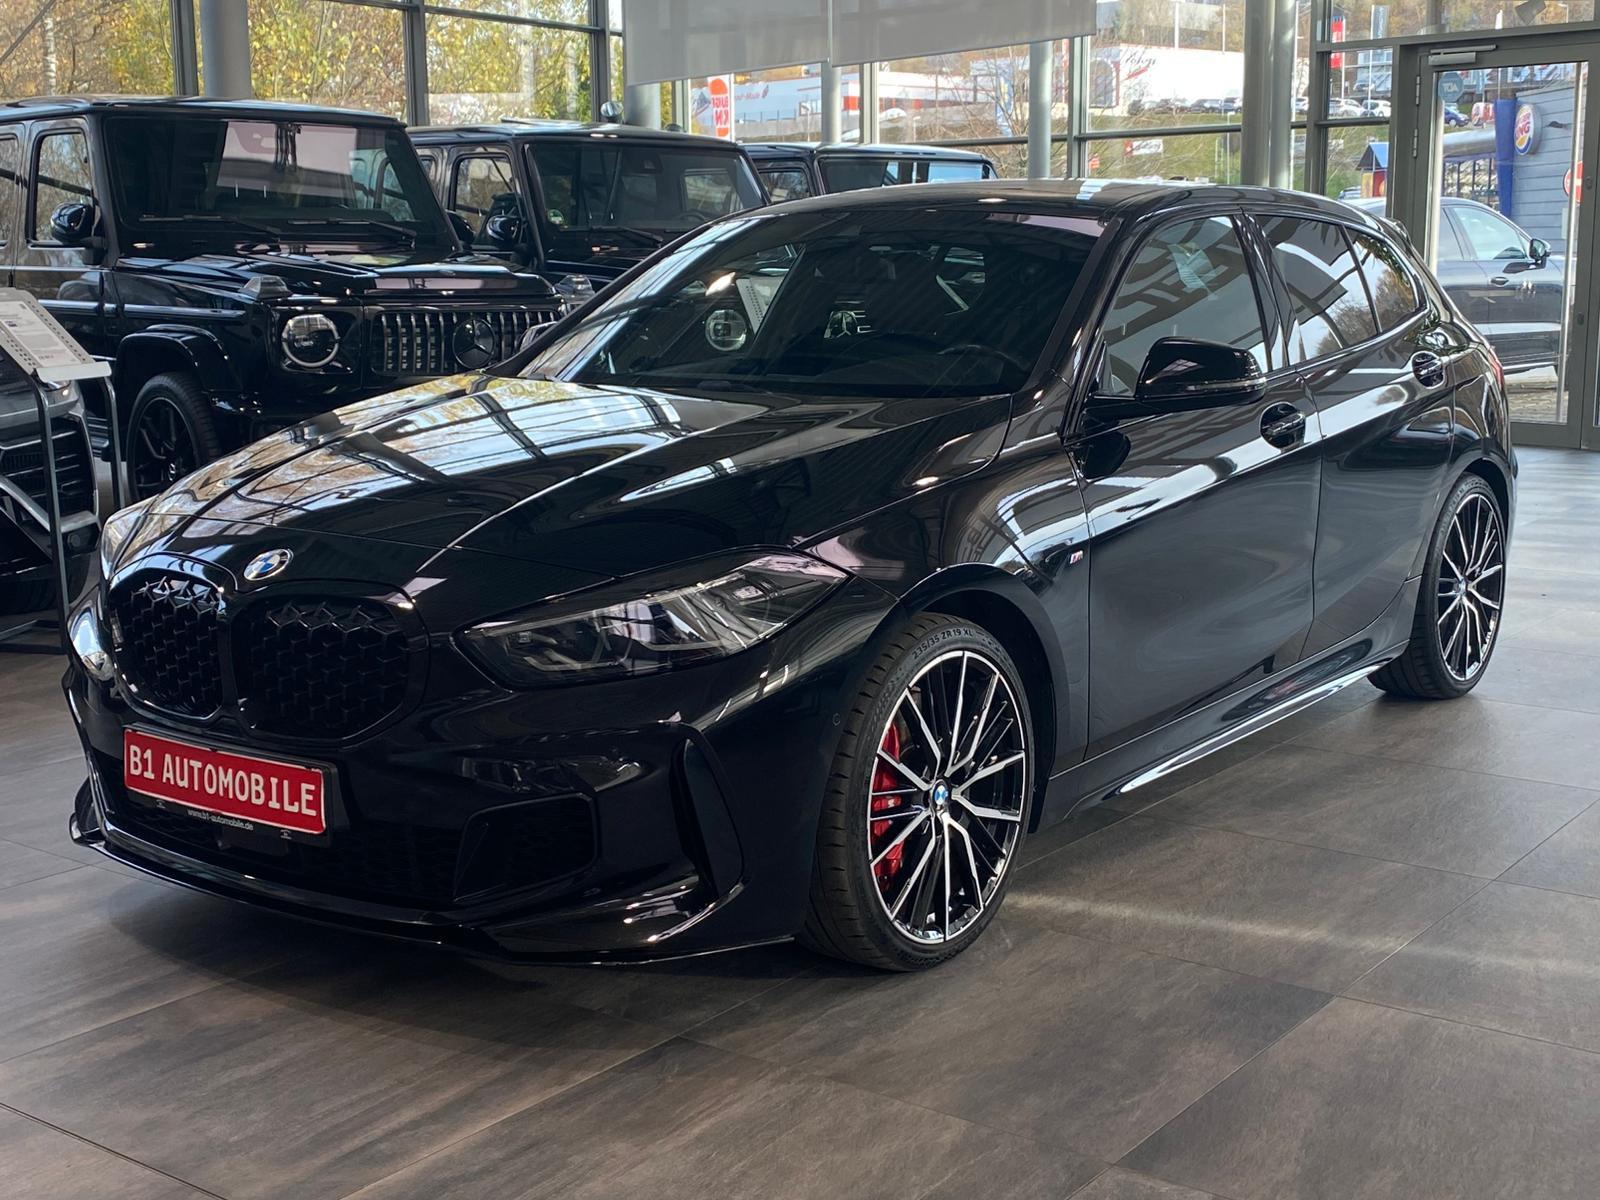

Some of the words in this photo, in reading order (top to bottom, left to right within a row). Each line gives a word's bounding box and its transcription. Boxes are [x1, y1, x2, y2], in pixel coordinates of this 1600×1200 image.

[912, 634, 940, 659] 235/35
[941, 630, 952, 640] ZR
[963, 628, 974, 637] XL
[129, 745, 155, 780] B1
[162, 753, 317, 816] AUTOMOBILE
